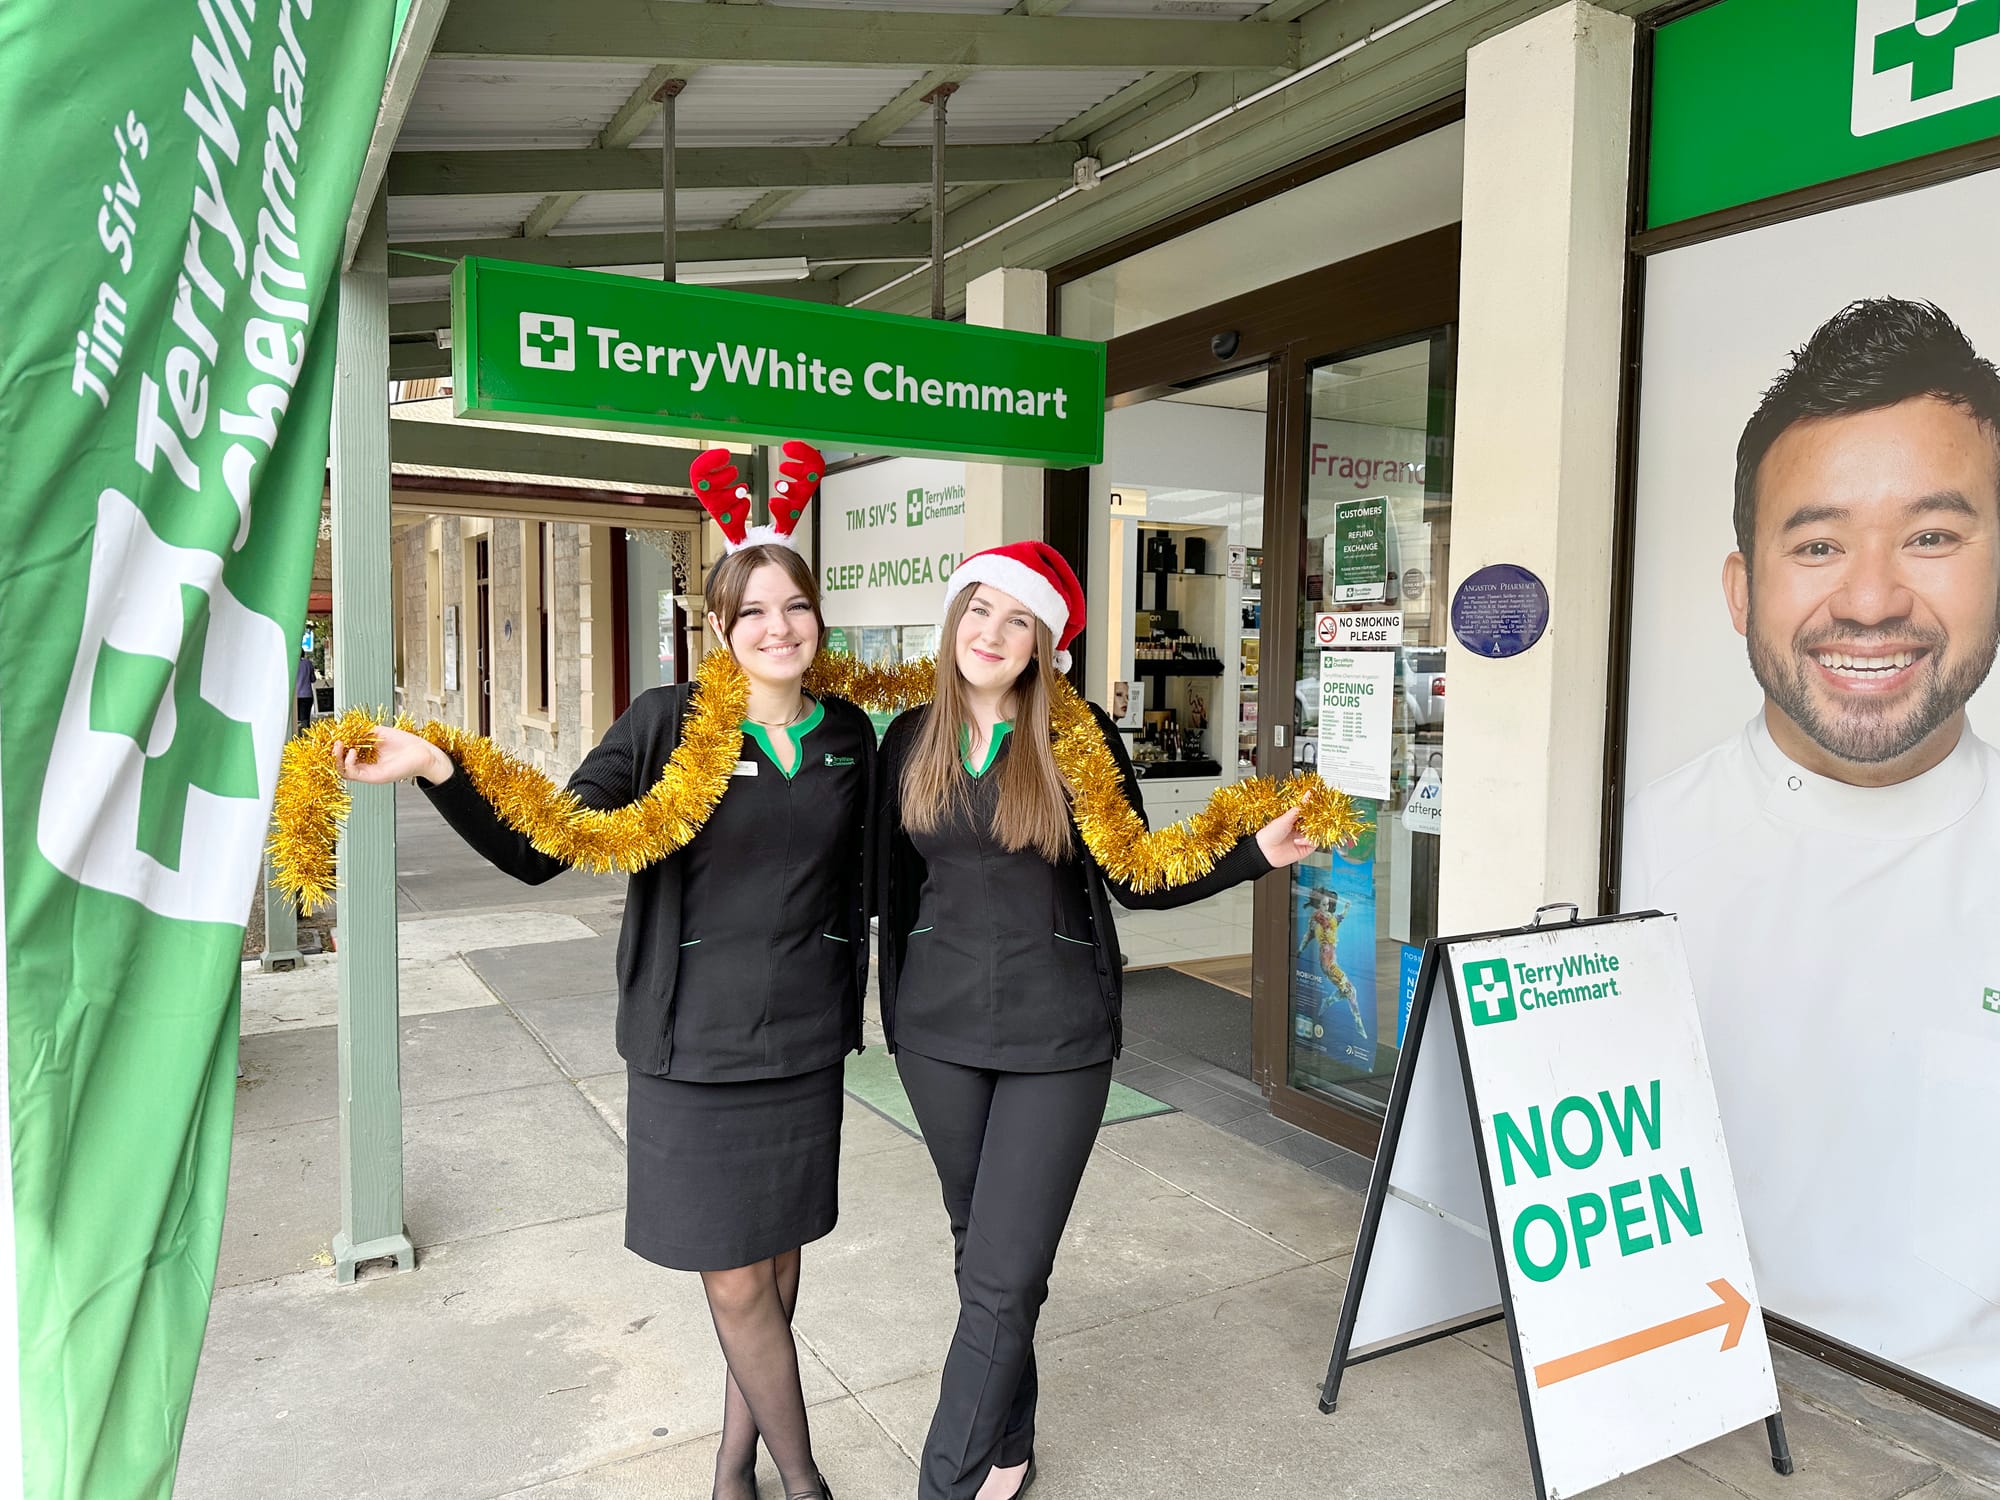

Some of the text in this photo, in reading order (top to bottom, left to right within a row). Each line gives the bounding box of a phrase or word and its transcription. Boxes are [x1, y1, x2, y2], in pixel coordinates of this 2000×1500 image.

[72, 109, 149, 409] Tim Siv's
[587, 326, 1068, 419] TerryWhite Chemmart
[925, 485, 965, 506] TerryWhit
[846, 502, 897, 531] TIM SIV'S
[925, 501, 965, 520] Chemmart
[1340, 506, 1382, 519] CUSTOMERS
[1348, 529, 1374, 539] REFUND
[1344, 542, 1378, 553] EXCHANGE
[826, 564, 864, 592] SLEEP
[868, 556, 933, 588] APNOEA
[1339, 616, 1400, 627] NO SMOKING
[1350, 631, 1387, 641] PLEASE
[1323, 681, 1374, 695] OPENING
[1323, 694, 1360, 708] HOURS
[1514, 952, 1619, 986] TerryWhite
[1519, 977, 1620, 1011] Chemmart
[1492, 1079, 1663, 1186] NOW
[1512, 1166, 1703, 1283] OPEN
